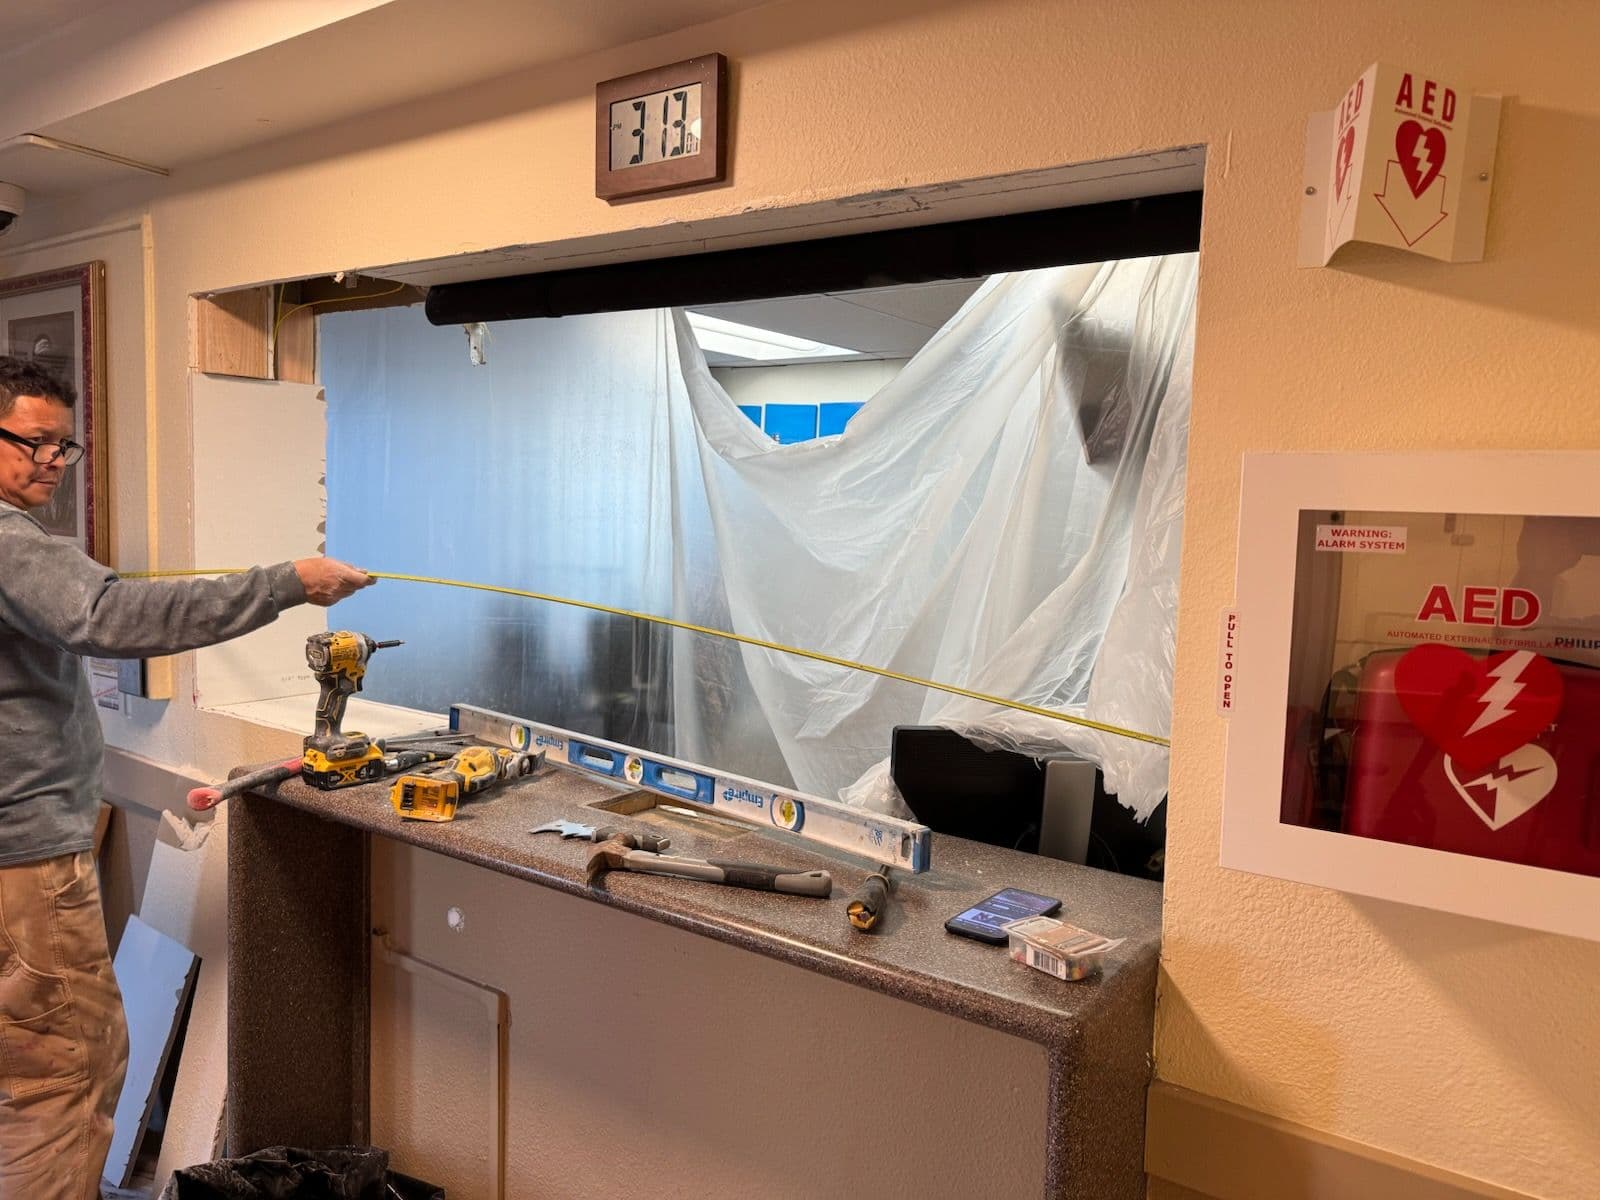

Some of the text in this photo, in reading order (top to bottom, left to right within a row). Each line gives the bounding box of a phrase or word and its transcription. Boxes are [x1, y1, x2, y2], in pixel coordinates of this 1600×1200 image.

[1338, 78, 1364, 135] AED
[1395, 73, 1456, 123] AED
[1317, 540, 1405, 550] ALARM SYSTEM
[1331, 529, 1392, 538] WARNING:
[1416, 585, 1541, 628] AED
[1387, 631, 1442, 641] AUTOMATED
[1444, 635, 1494, 644] EXTERNAL
[1223, 614, 1236, 708] PULL TO OPEN
[725, 788, 763, 808] Empire
